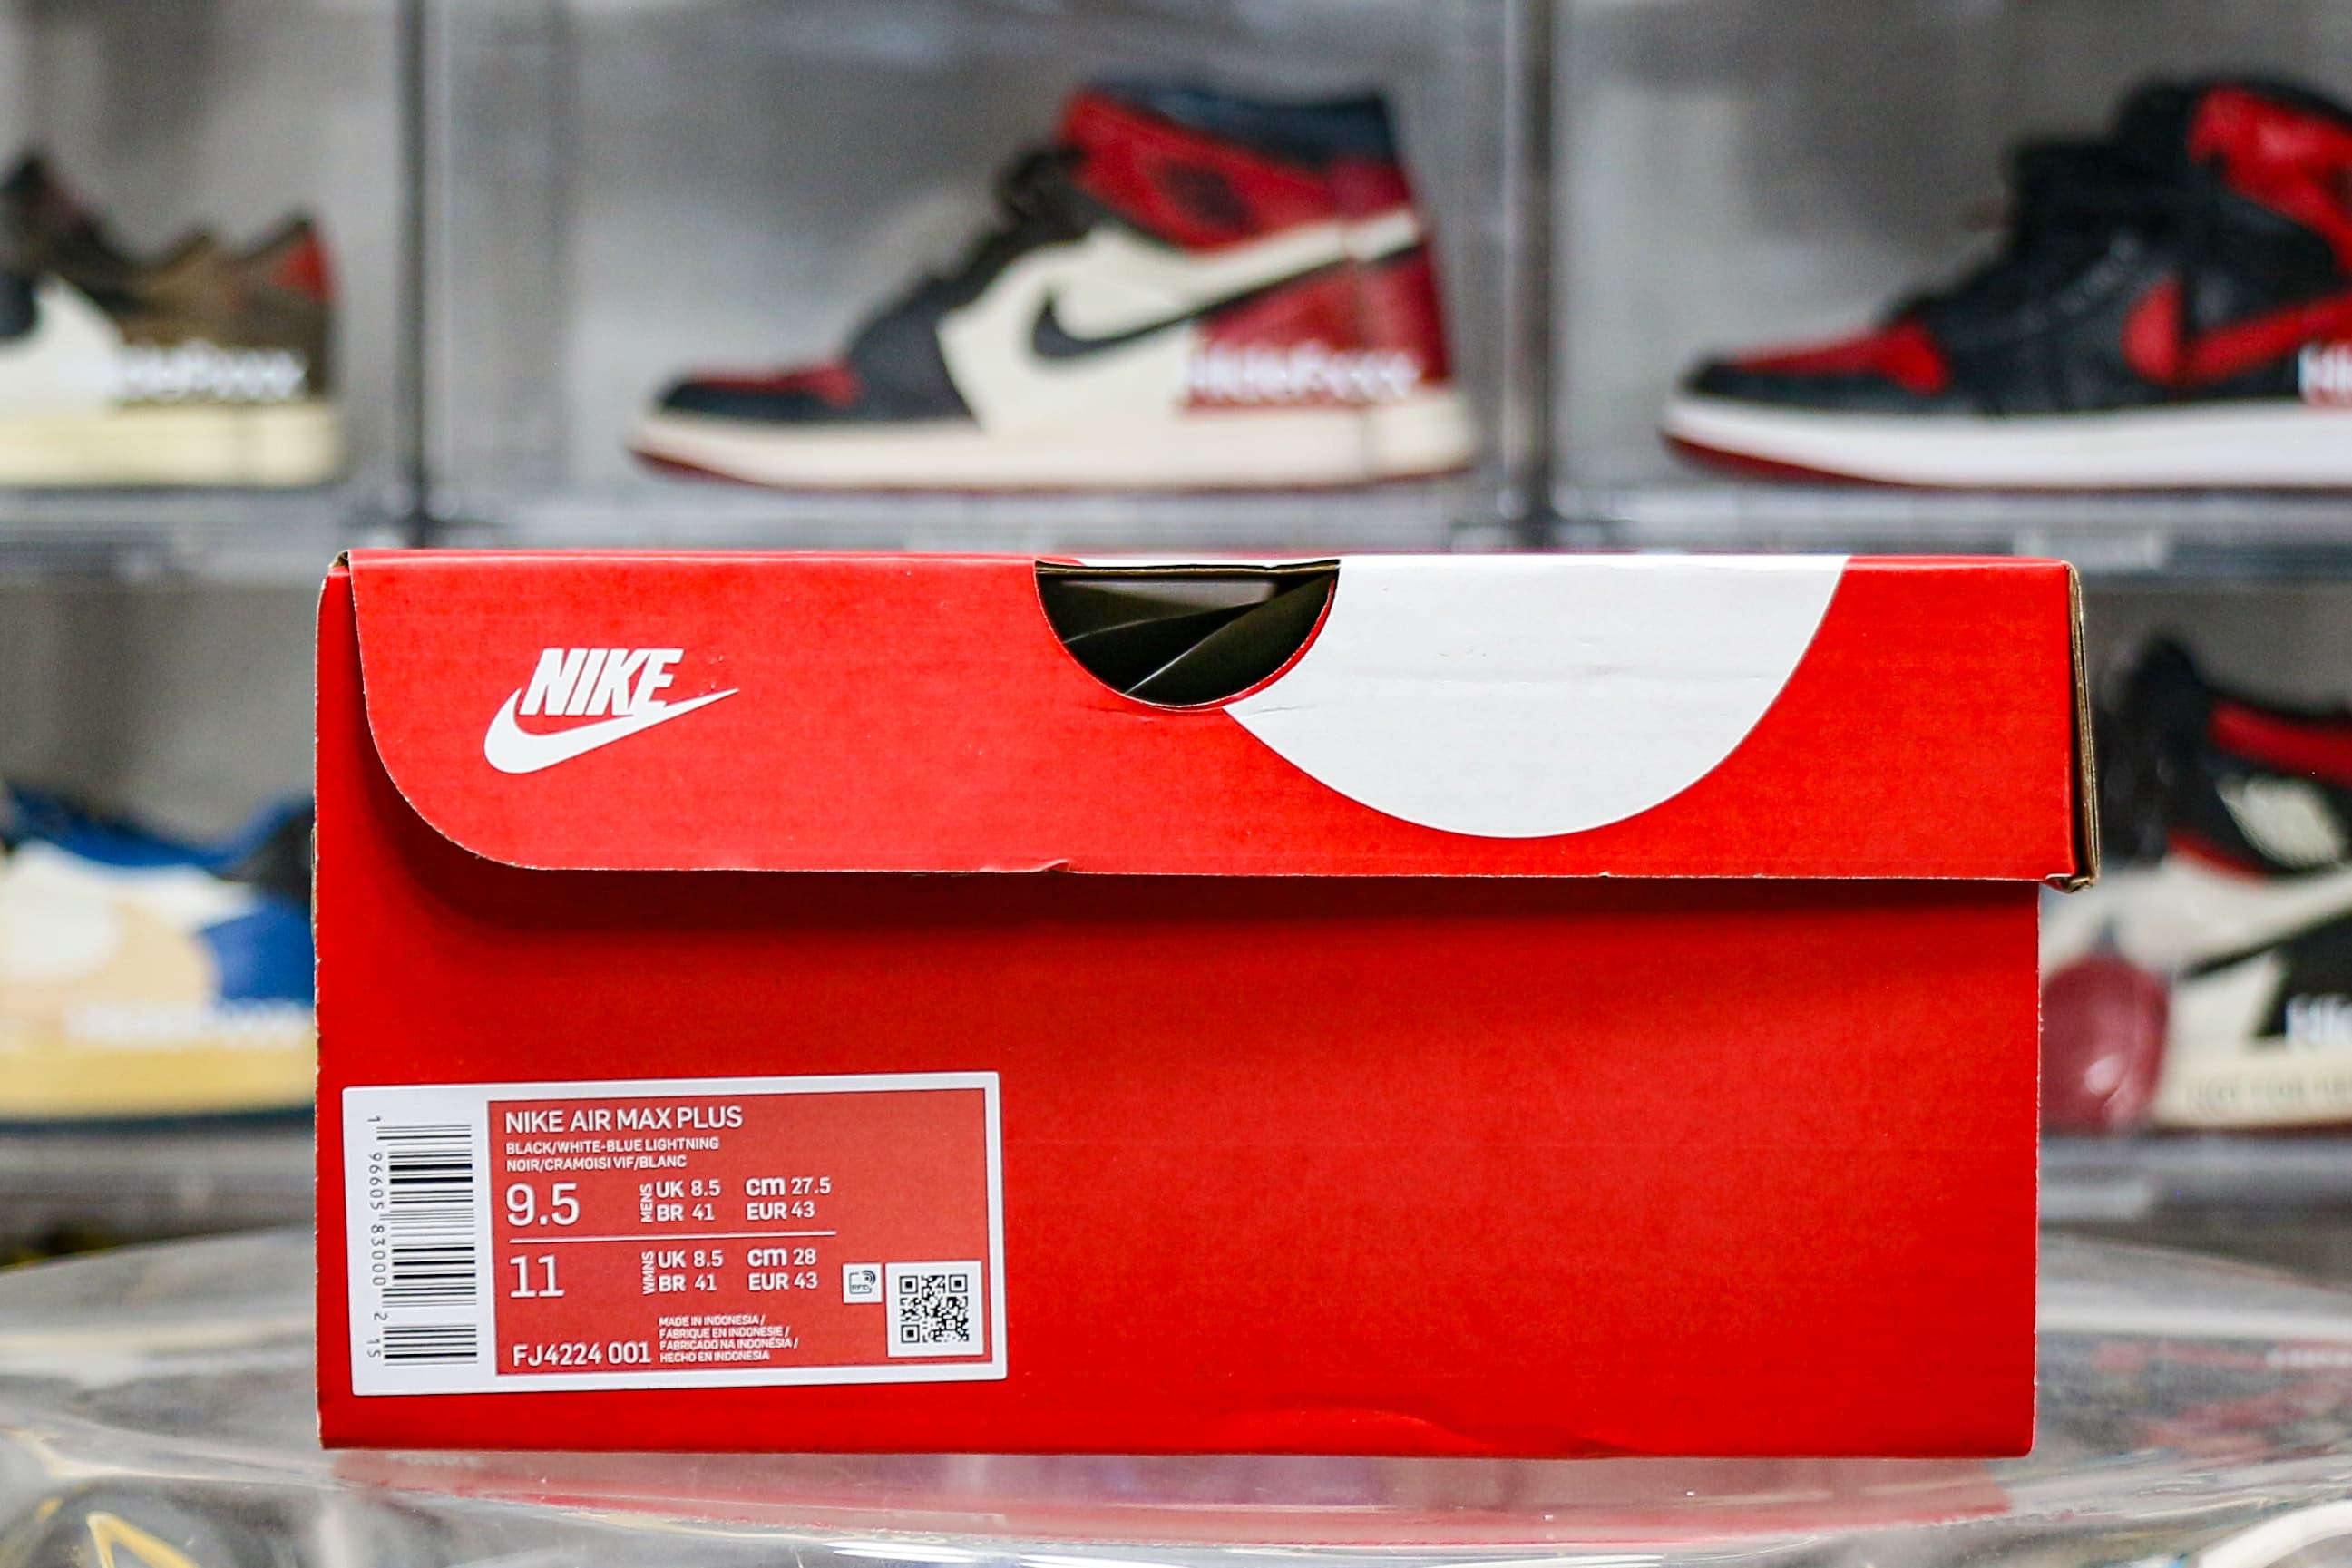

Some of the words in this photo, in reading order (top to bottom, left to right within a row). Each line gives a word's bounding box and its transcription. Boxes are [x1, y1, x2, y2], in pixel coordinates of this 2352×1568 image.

[517, 648, 685, 716] NIKE
[366, 1115, 382, 1124] 1
[506, 1110, 564, 1133] NIKE
[570, 1109, 611, 1131] AIR
[617, 1107, 671, 1130] MAX
[678, 1106, 742, 1128] PLUS
[506, 1139, 642, 1155] BLACK/WHITE-BLUE
[645, 1137, 719, 1151] LIGHTNING
[507, 1157, 611, 1172] NOIR/CRAMOISI
[613, 1154, 687, 1170] VIF/BLANC
[369, 1152, 385, 1211] 96605
[657, 1181, 684, 1197] UK
[691, 1179, 720, 1196] 8.5
[747, 1178, 786, 1196] cm
[791, 1177, 831, 1194] 27.5
[507, 1183, 579, 1225] 9.5
[639, 1183, 653, 1222] MENS
[747, 1203, 786, 1220] EUR
[792, 1201, 815, 1217] 43
[657, 1204, 683, 1221] BR
[692, 1203, 714, 1220] 41
[370, 1223, 387, 1287] 83000
[659, 1251, 686, 1268] UK
[694, 1250, 723, 1267] 8.5
[748, 1249, 786, 1266] cm
[794, 1248, 816, 1265] 28
[511, 1255, 564, 1297] 11
[641, 1251, 655, 1294] WMNS
[749, 1273, 789, 1290] EUR
[795, 1271, 818, 1289] 43
[659, 1275, 685, 1291] BR
[695, 1274, 717, 1290] 41
[373, 1312, 388, 1321] 2
[659, 1316, 689, 1327] MADE
[691, 1317, 702, 1325] IN
[704, 1315, 758, 1325] INDONESIA
[659, 1328, 710, 1339] FABRIQUE
[712, 1328, 727, 1338] EN
[513, 1343, 602, 1366] FJ4224
[609, 1341, 652, 1363] 001
[660, 1339, 719, 1350] FABRICADO
[720, 1339, 735, 1349] NA
[660, 1352, 697, 1362] HECHO
[698, 1352, 712, 1361] EN
[714, 1350, 770, 1361] INDONESIA
